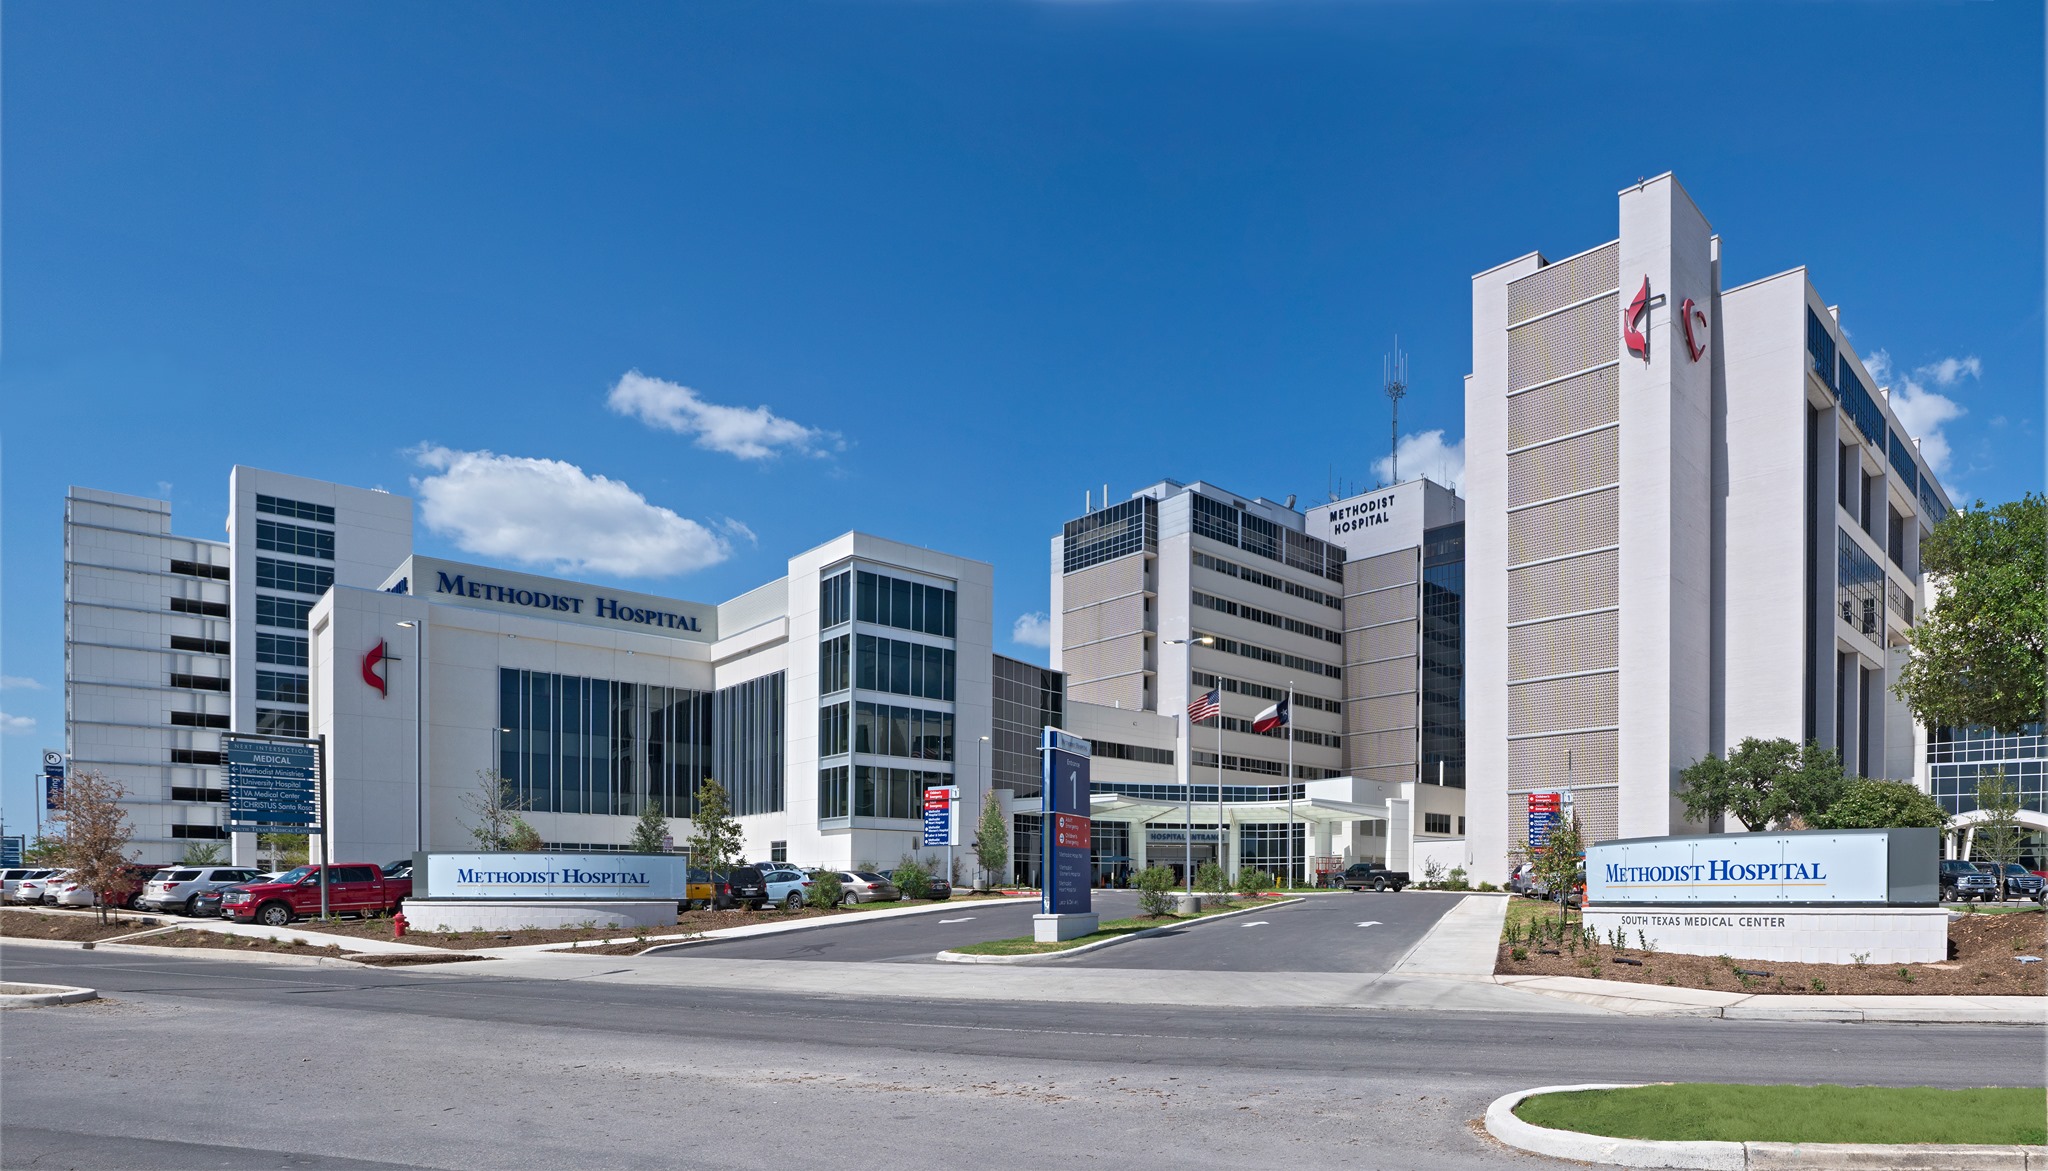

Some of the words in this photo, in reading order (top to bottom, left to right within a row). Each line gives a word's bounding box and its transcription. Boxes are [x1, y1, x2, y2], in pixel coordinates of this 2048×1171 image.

[1330, 495, 1395, 522] METHODIST
[1335, 512, 1389, 535] HOSPITAL
[436, 571, 584, 614] METHODIST
[596, 597, 702, 632] HOSPITAL
[256, 745, 308, 754] INTERSECTION
[253, 755, 291, 764] MEDICAL
[243, 778, 274, 788] University
[275, 780, 301, 788] Hospital
[1070, 771, 1076, 810] 1
[244, 801, 277, 809] CHRISTUS
[457, 868, 560, 884] METHODIST
[562, 869, 650, 884] HOSPITAL
[1606, 863, 1705, 882] METHODIST
[1708, 860, 1827, 881] HOSPITAL
[1621, 916, 1648, 925] SOUTH
[1651, 916, 1680, 926] TEXAS
[1684, 917, 1733, 927] MEDICAL
[1739, 917, 1785, 928] CENTER
